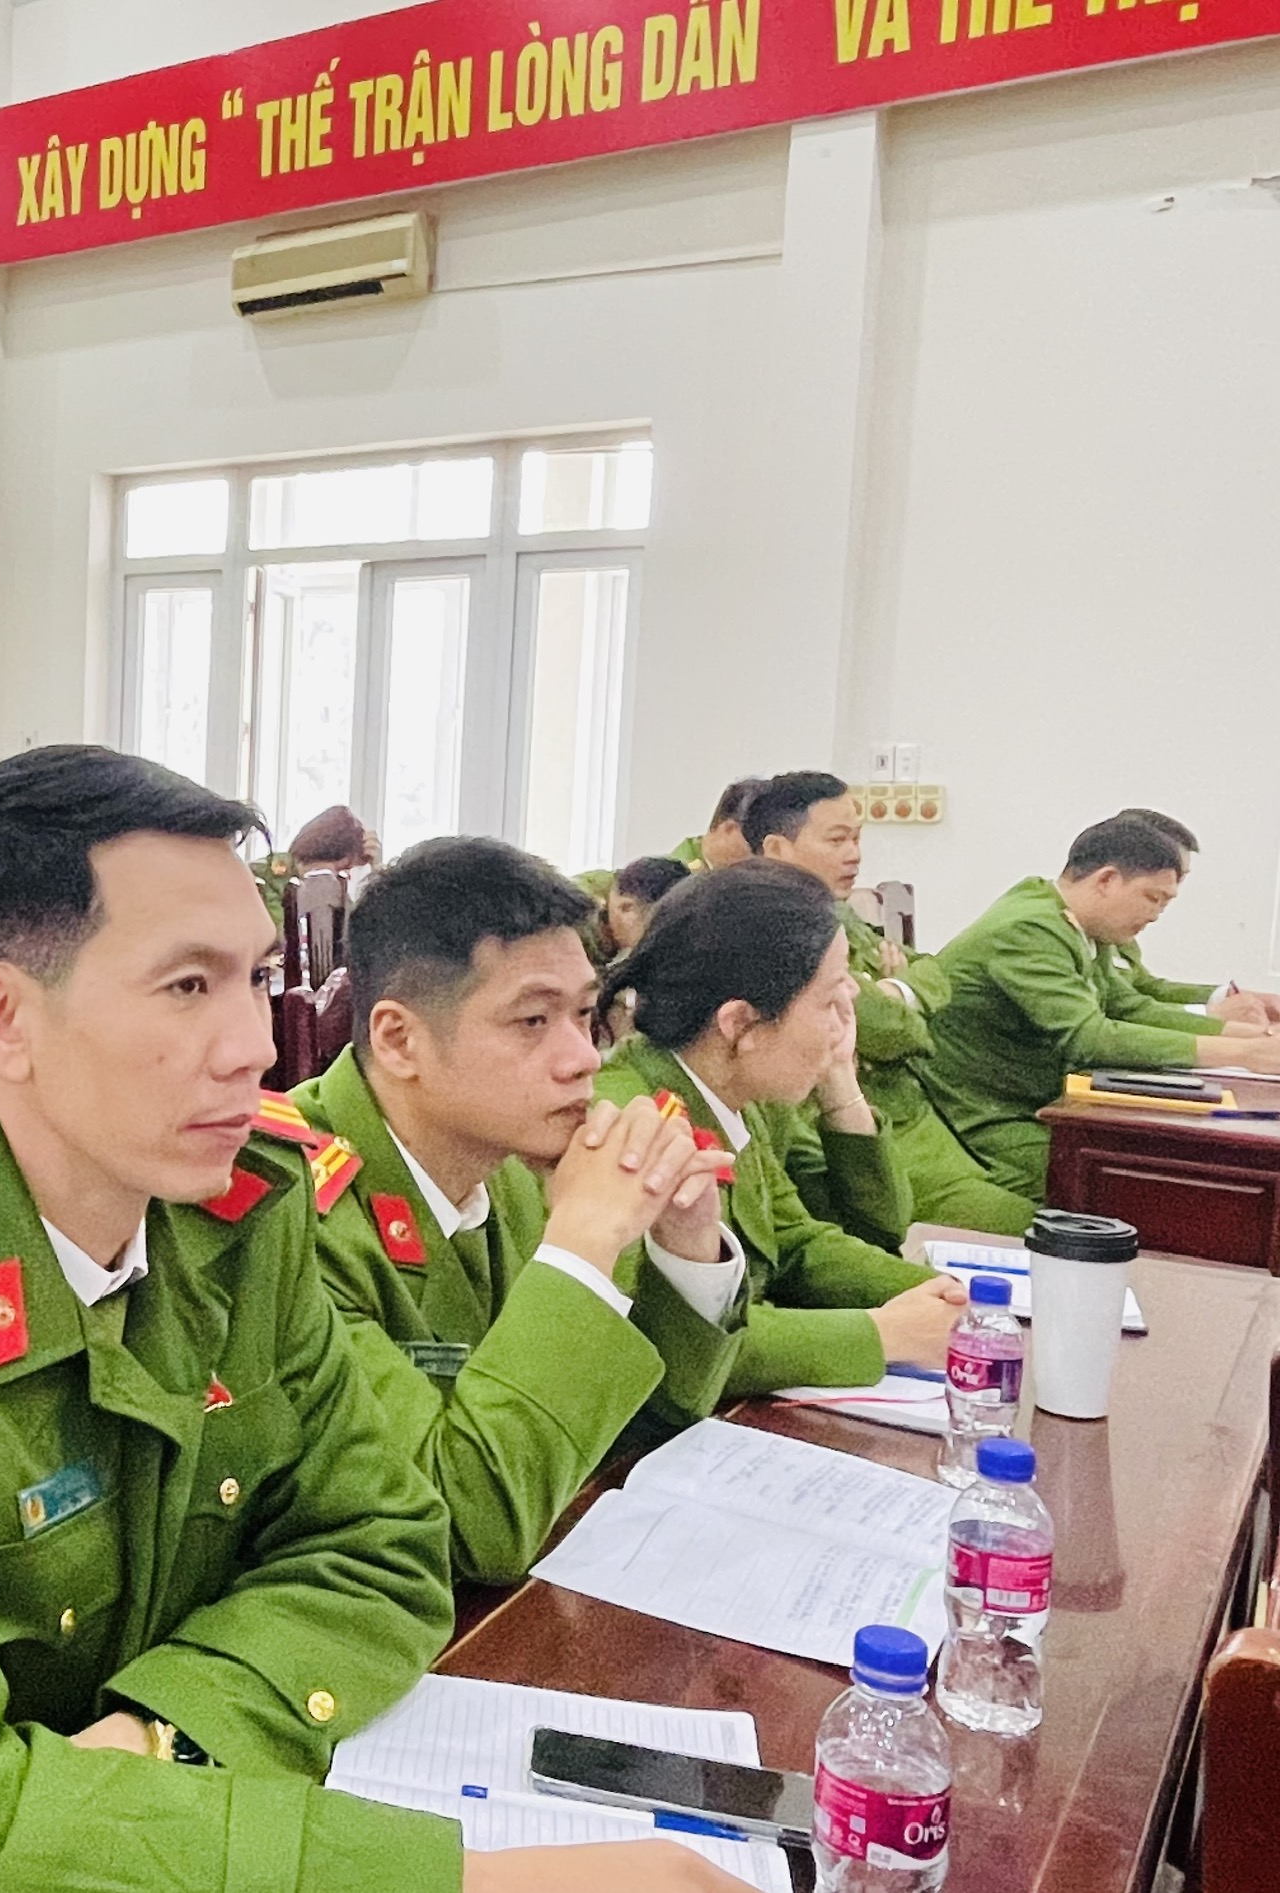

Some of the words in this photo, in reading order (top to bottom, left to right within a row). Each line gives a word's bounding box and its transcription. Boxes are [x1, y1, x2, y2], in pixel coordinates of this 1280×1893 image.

[17, 135, 87, 226] XÂY
[99, 117, 207, 220] DỰNG
[255, 57, 341, 178] THẾ
[349, 49, 472, 166] TRẬN
[488, 22, 624, 131] LÒNG
